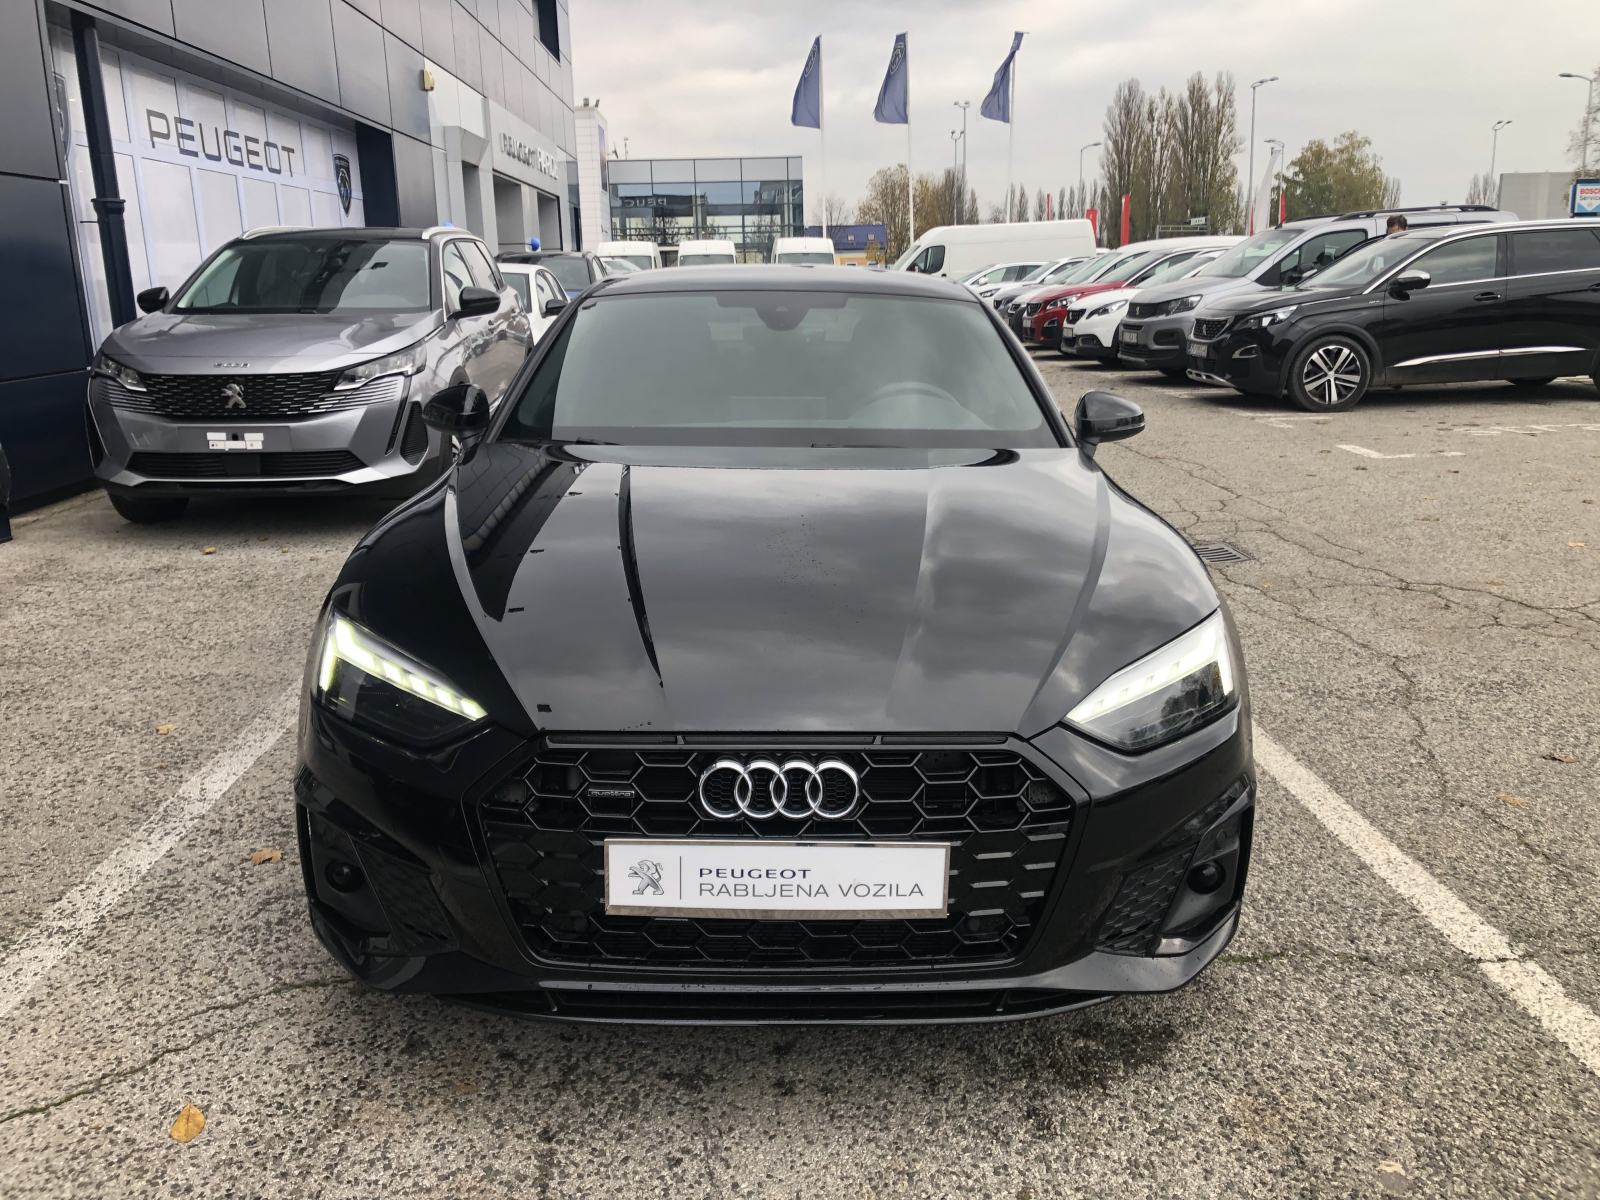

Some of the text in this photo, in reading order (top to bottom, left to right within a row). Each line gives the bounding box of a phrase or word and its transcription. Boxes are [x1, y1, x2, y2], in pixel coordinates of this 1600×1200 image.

[146, 108, 295, 178] PEUGEOT
[699, 868, 812, 879] PEUGEOT
[699, 883, 924, 898] RABLJENA VOZILA
